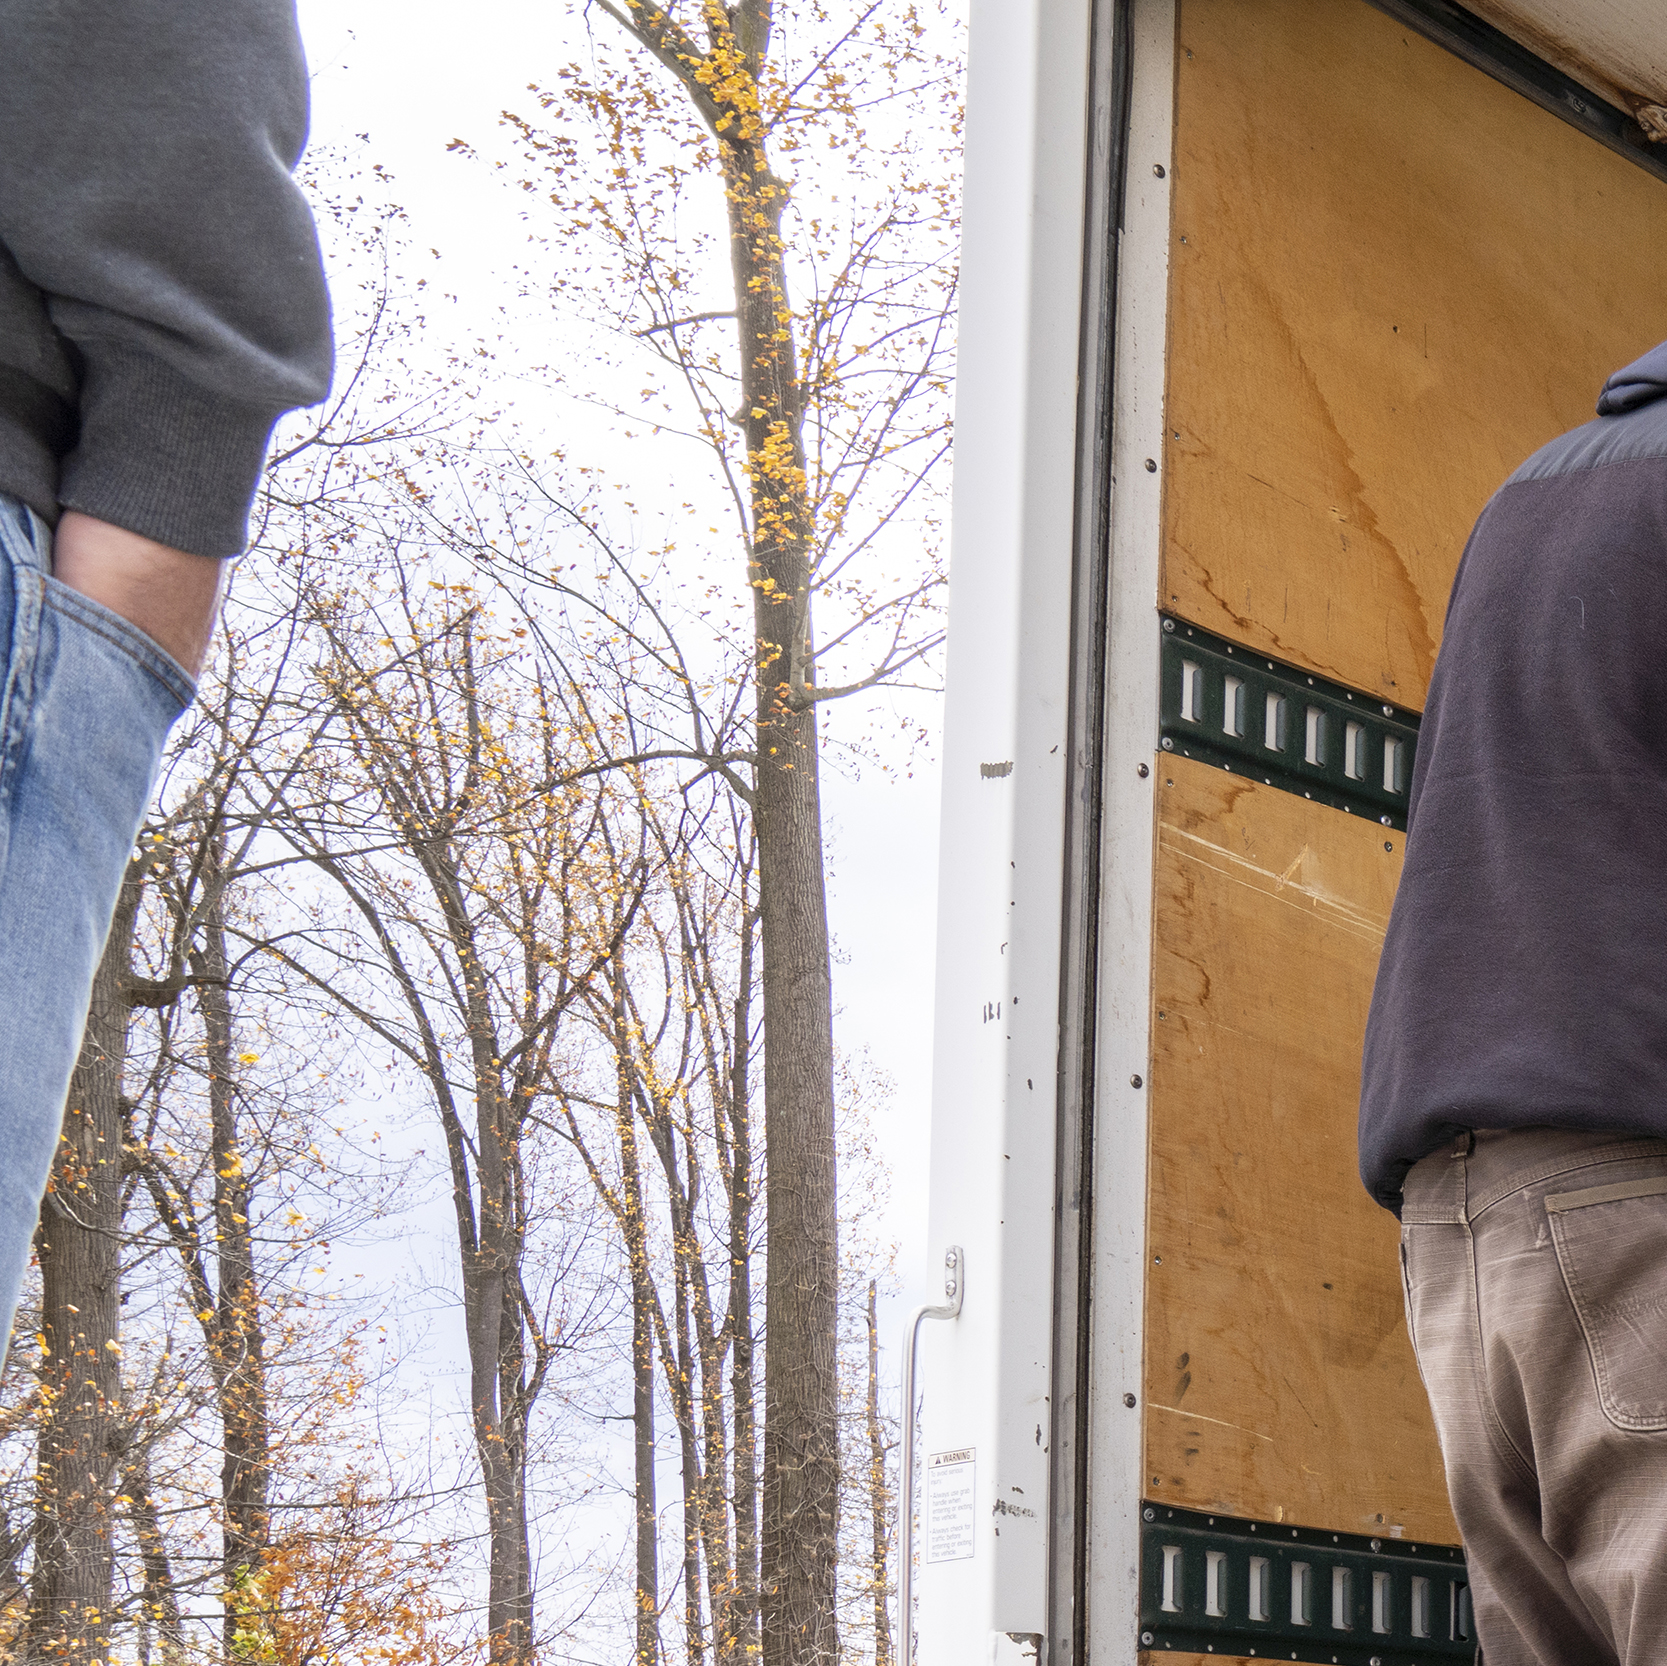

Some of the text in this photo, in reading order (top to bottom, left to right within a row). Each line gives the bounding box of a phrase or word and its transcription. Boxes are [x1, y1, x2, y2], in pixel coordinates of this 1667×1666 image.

[943, 1451, 971, 1463] WARNING
[932, 1491, 949, 1499] Always
[960, 1487, 970, 1496] grab
[932, 1498, 947, 1506] handle
[932, 1506, 951, 1515] entering
[958, 1503, 973, 1511] exiting
[950, 1524, 963, 1532] check
[932, 1534, 945, 1542] traffic
[932, 1542, 950, 1550] entering
[957, 1539, 972, 1547] exiting
